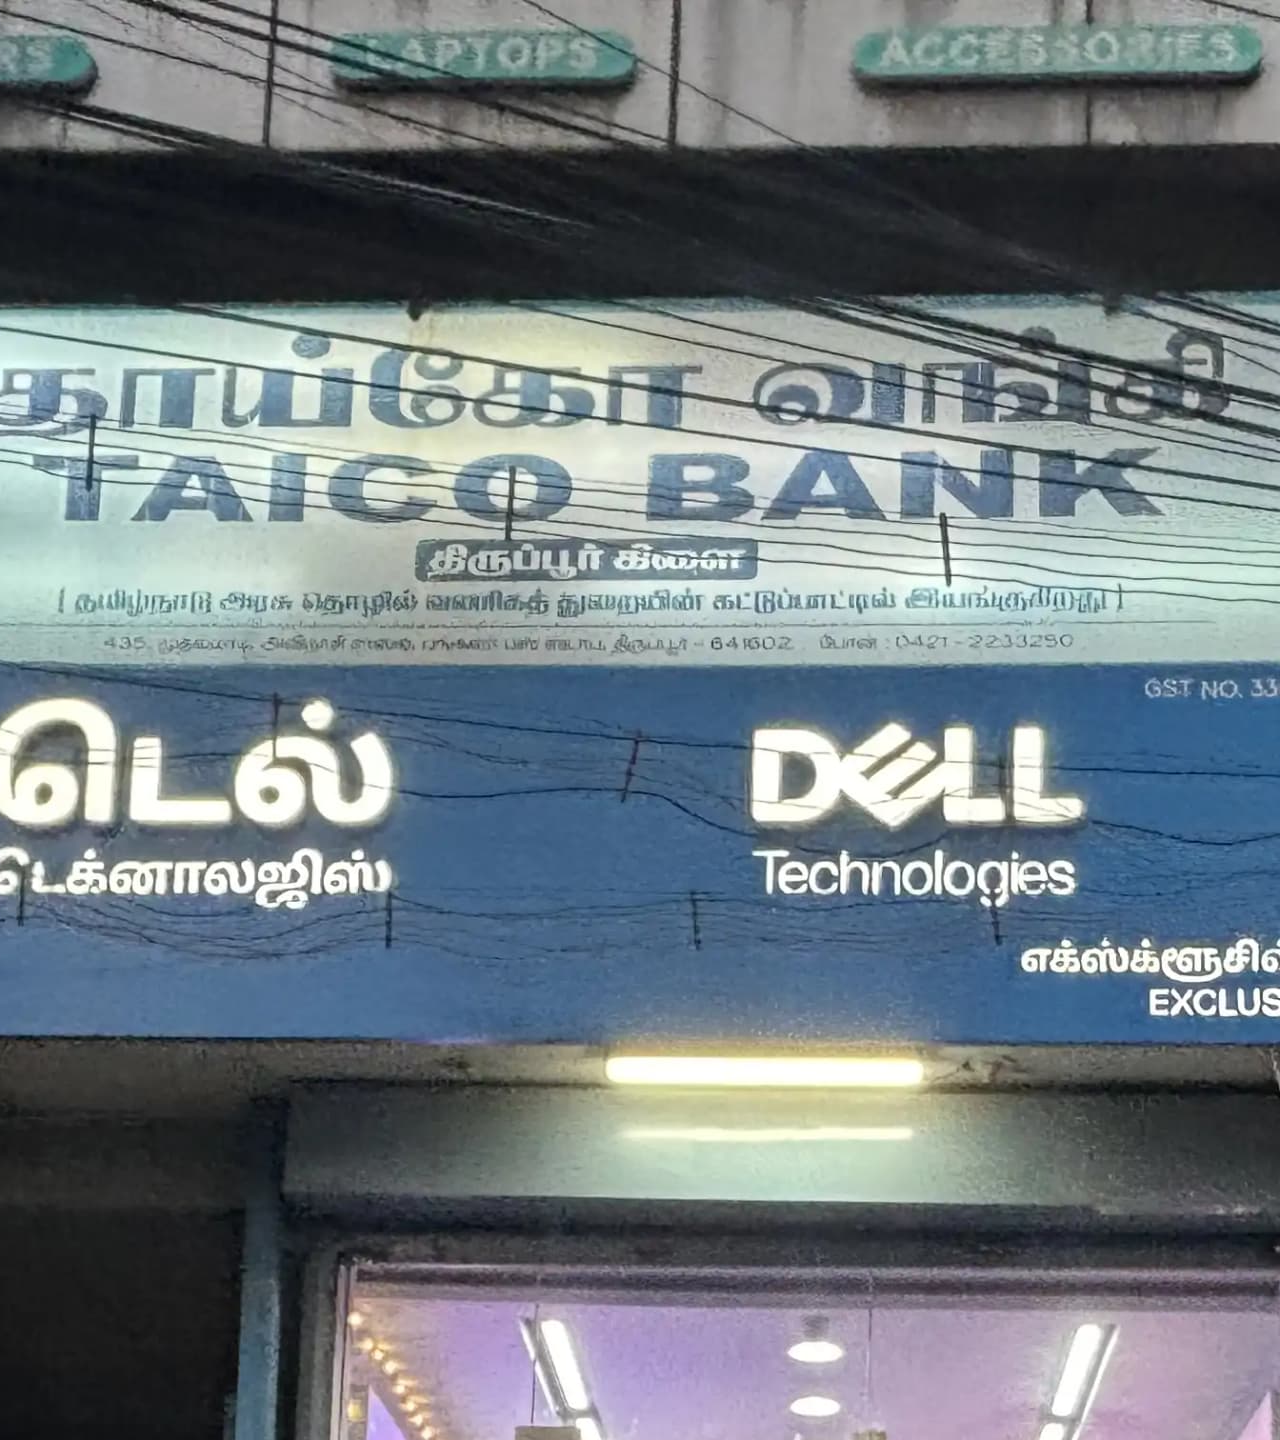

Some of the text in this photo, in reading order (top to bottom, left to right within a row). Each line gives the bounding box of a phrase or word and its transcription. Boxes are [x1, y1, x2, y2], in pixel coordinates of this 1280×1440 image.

[879, 31, 1236, 68] ACCESSORIES
[33, 448, 1167, 524] TAICO BANK
[427, 542, 605, 579] திருப்பூர்
[1143, 678, 1193, 699] GST
[1201, 678, 1243, 700] NO.
[750, 721, 1086, 828] DELL
[752, 848, 1077, 908] Technologies
